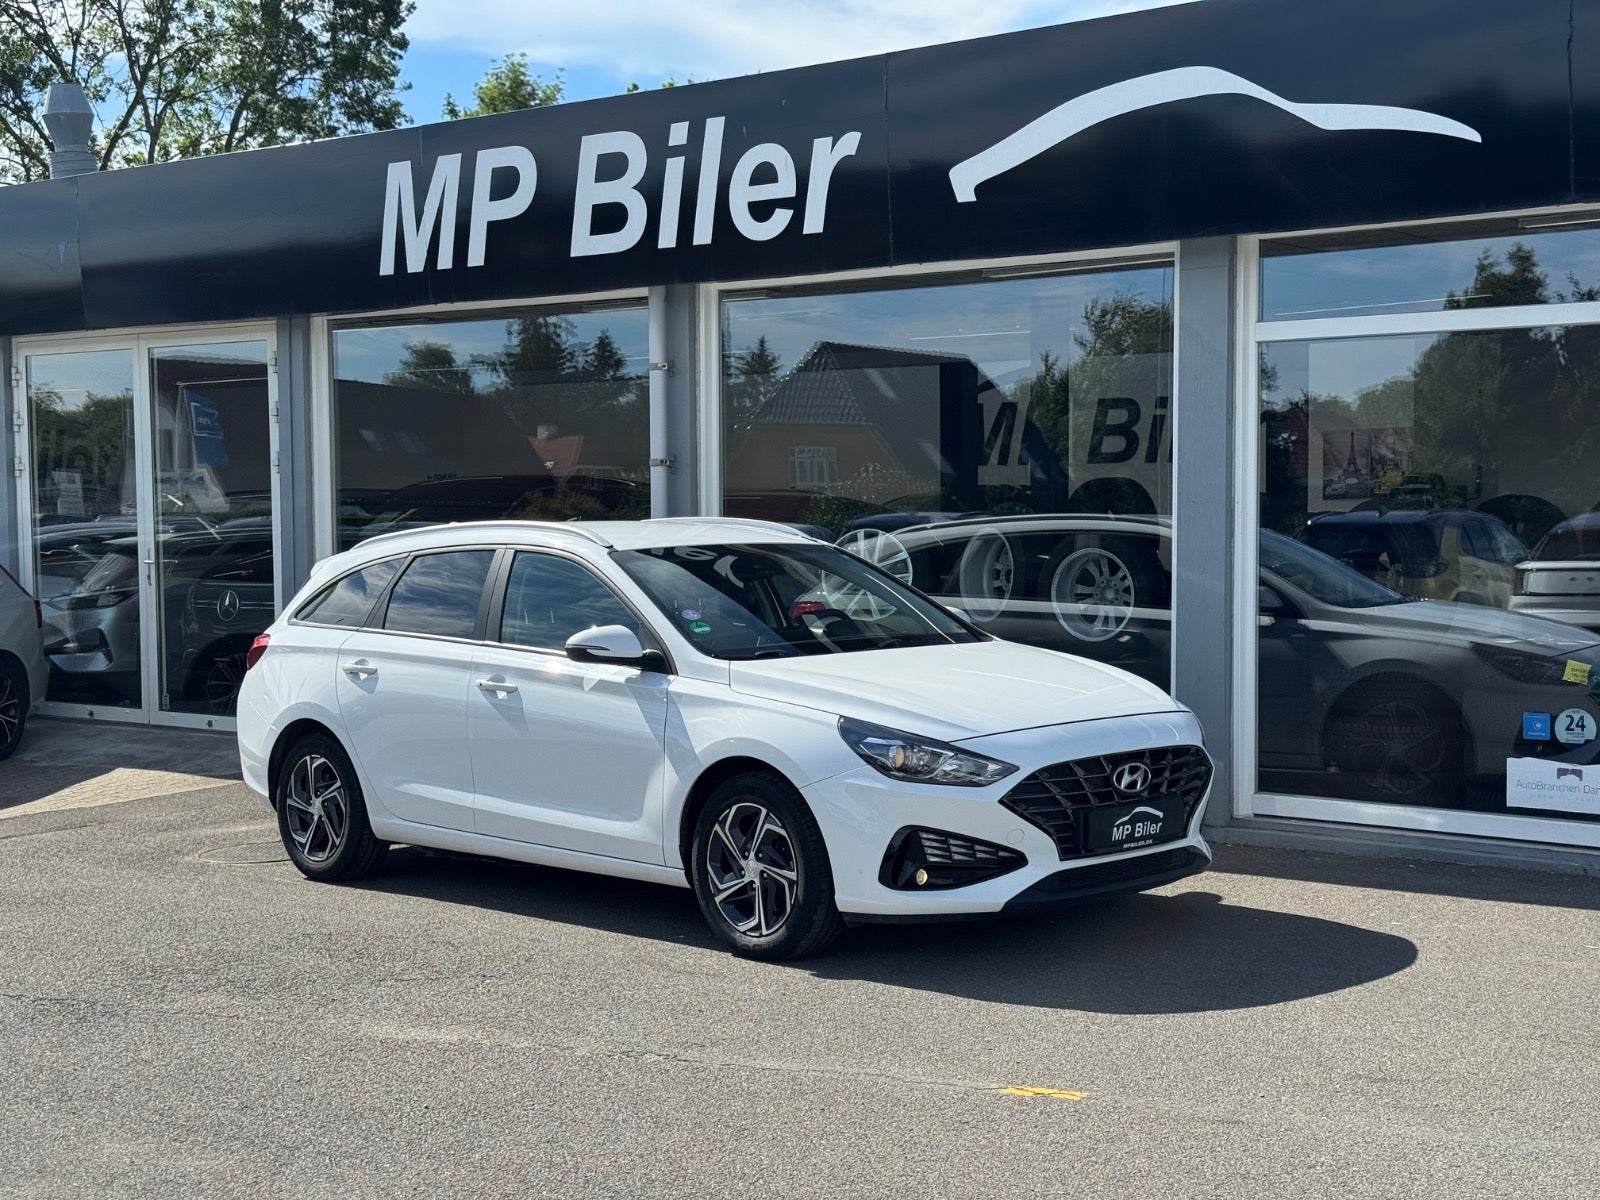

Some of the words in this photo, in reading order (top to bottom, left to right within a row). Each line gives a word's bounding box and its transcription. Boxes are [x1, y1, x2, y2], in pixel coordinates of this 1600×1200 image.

[379, 145, 538, 276] MP
[569, 116, 862, 258] Biler
[1087, 396, 1173, 464] Bi
[1565, 714, 1586, 732] 24
[1516, 780, 1580, 793] AutoBranchen
[1112, 825, 1131, 841] MP
[1135, 821, 1162, 837] Biler
